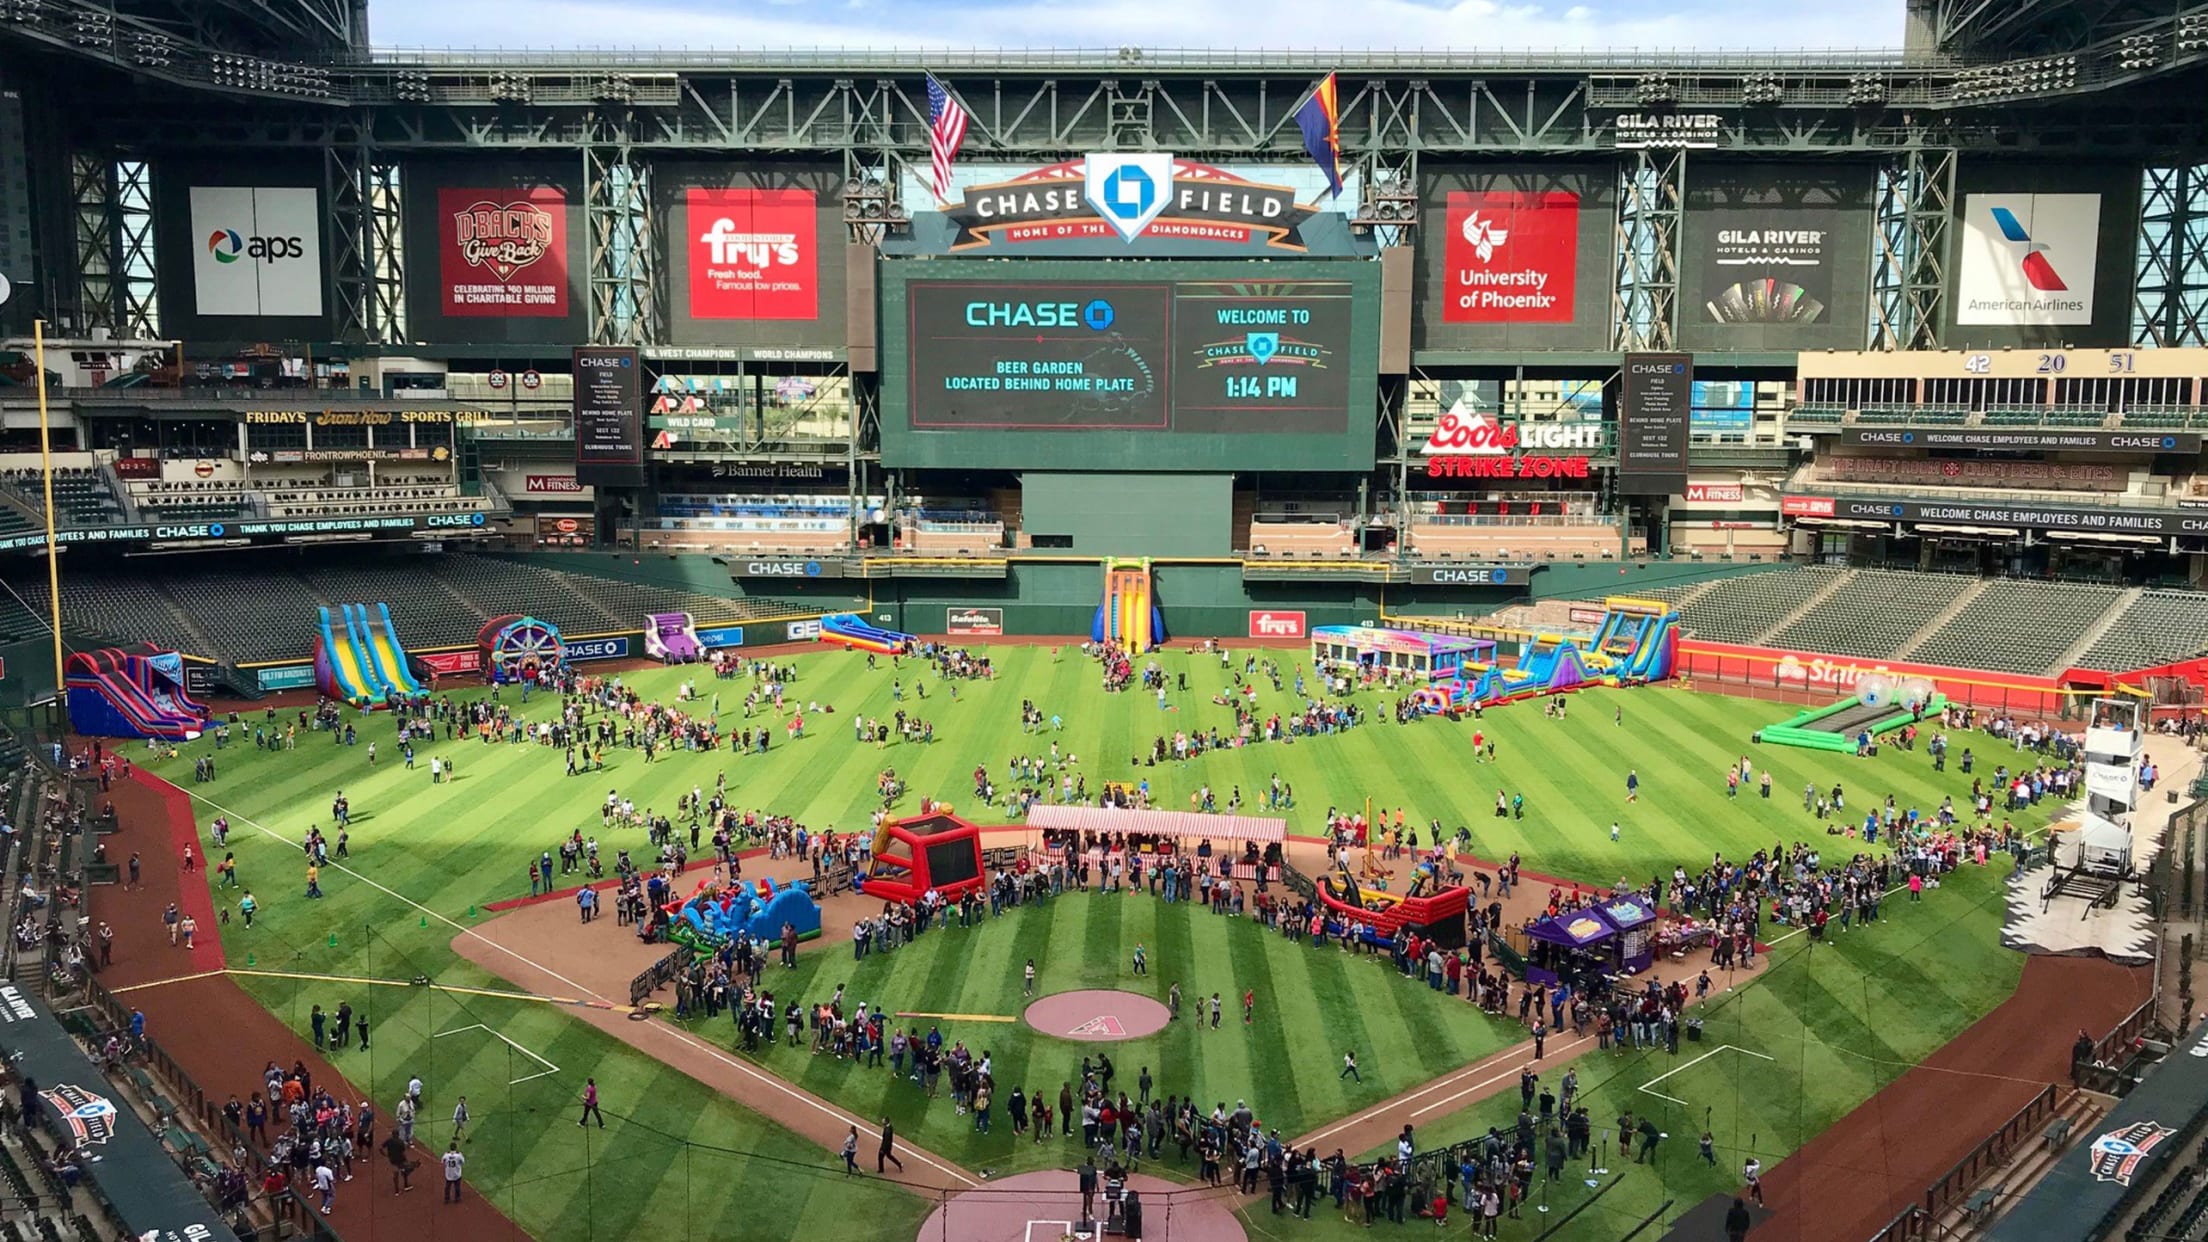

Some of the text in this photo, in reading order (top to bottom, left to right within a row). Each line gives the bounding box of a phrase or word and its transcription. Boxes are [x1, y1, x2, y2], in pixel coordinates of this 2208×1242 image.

[1616, 114, 1718, 128] GILA RIVER
[976, 189, 1281, 218] CHASE FIELD
[1013, 225, 1244, 239] HOME OF THE DIAMONDBACKS
[1717, 230, 1821, 244] GILA RIVER
[247, 236, 303, 264] aps
[700, 217, 799, 269] fry's
[466, 240, 541, 264] Give Back
[707, 269, 763, 279] Fresh food.
[1460, 269, 1548, 290] University
[454, 285, 505, 294] CELEBRATING
[524, 285, 556, 294] MILLION
[716, 280, 753, 290] Famous
[454, 294, 556, 304] IN CHARITABLE GIVING
[1459, 290, 1479, 308] of
[1968, 299, 2083, 311] American Airlines
[966, 302, 1079, 326] CHASE
[1217, 309, 1310, 324] WELCOME TO
[646, 349, 736, 358] NL WEST CHAMPIONS
[754, 350, 834, 359] WORLD CHAMPIONS
[1207, 345, 1318, 356] CHASE FIELD
[580, 358, 619, 367] CHASE
[996, 362, 1083, 374] BEER GARDEN
[1632, 364, 1673, 374] CHASE
[1965, 355, 1990, 374] 42
[2037, 355, 2066, 374] 20
[2109, 354, 2136, 373] 51
[945, 377, 1134, 390] LOCATED BEHIND HOME PLATE
[1226, 377, 1297, 397] 1:14 PM
[246, 411, 307, 423] FRIDAY'S
[359, 408, 392, 424] Row
[401, 411, 452, 422] SPORTS
[455, 411, 492, 422] GRILL
[667, 418, 716, 428] WILD CARD
[1429, 414, 1602, 449] Coors LIGHT
[1860, 432, 2161, 448] CHASE WELCOME CHASE EMPLOYEES AND FAMILIES CHASE
[304, 450, 400, 460] FRONTROWPHOENIX.com
[728, 465, 823, 478] Banner Health
[1427, 456, 1589, 478] STRIKE ZONE
[1855, 459, 1898, 473] DRAFT
[2011, 463, 2048, 479] BEER
[2070, 465, 2113, 480] BITES
[547, 481, 581, 490] FITNESS
[1706, 490, 1741, 500] FITNESS
[1850, 504, 2163, 529] CHASE WELCOME CHASE EMPLOYEES AND FAMILIES
[27, 535, 46, 545] CHASE
[88, 531, 107, 540] AND
[109, 528, 149, 539] FAMILIES
[156, 525, 209, 538] CHASE
[239, 524, 268, 533] THANK
[269, 523, 286, 532] YOU
[288, 522, 315, 531] CHASE
[316, 519, 362, 530] EMPLOYEES
[363, 518, 380, 528] AND
[381, 517, 415, 527] FAMILIES
[427, 514, 472, 526] CHASE
[748, 562, 804, 575] CHASE
[1433, 570, 1489, 582] CHASE
[878, 614, 892, 622] 413
[951, 614, 989, 623] Safelite
[1256, 614, 1297, 634] fry's
[1360, 620, 1375, 628] 413
[565, 643, 603, 657] HASE
[61, 1088, 105, 1137] CHASE FIELD
[2101, 1126, 2152, 1175] FIELD CHASE
